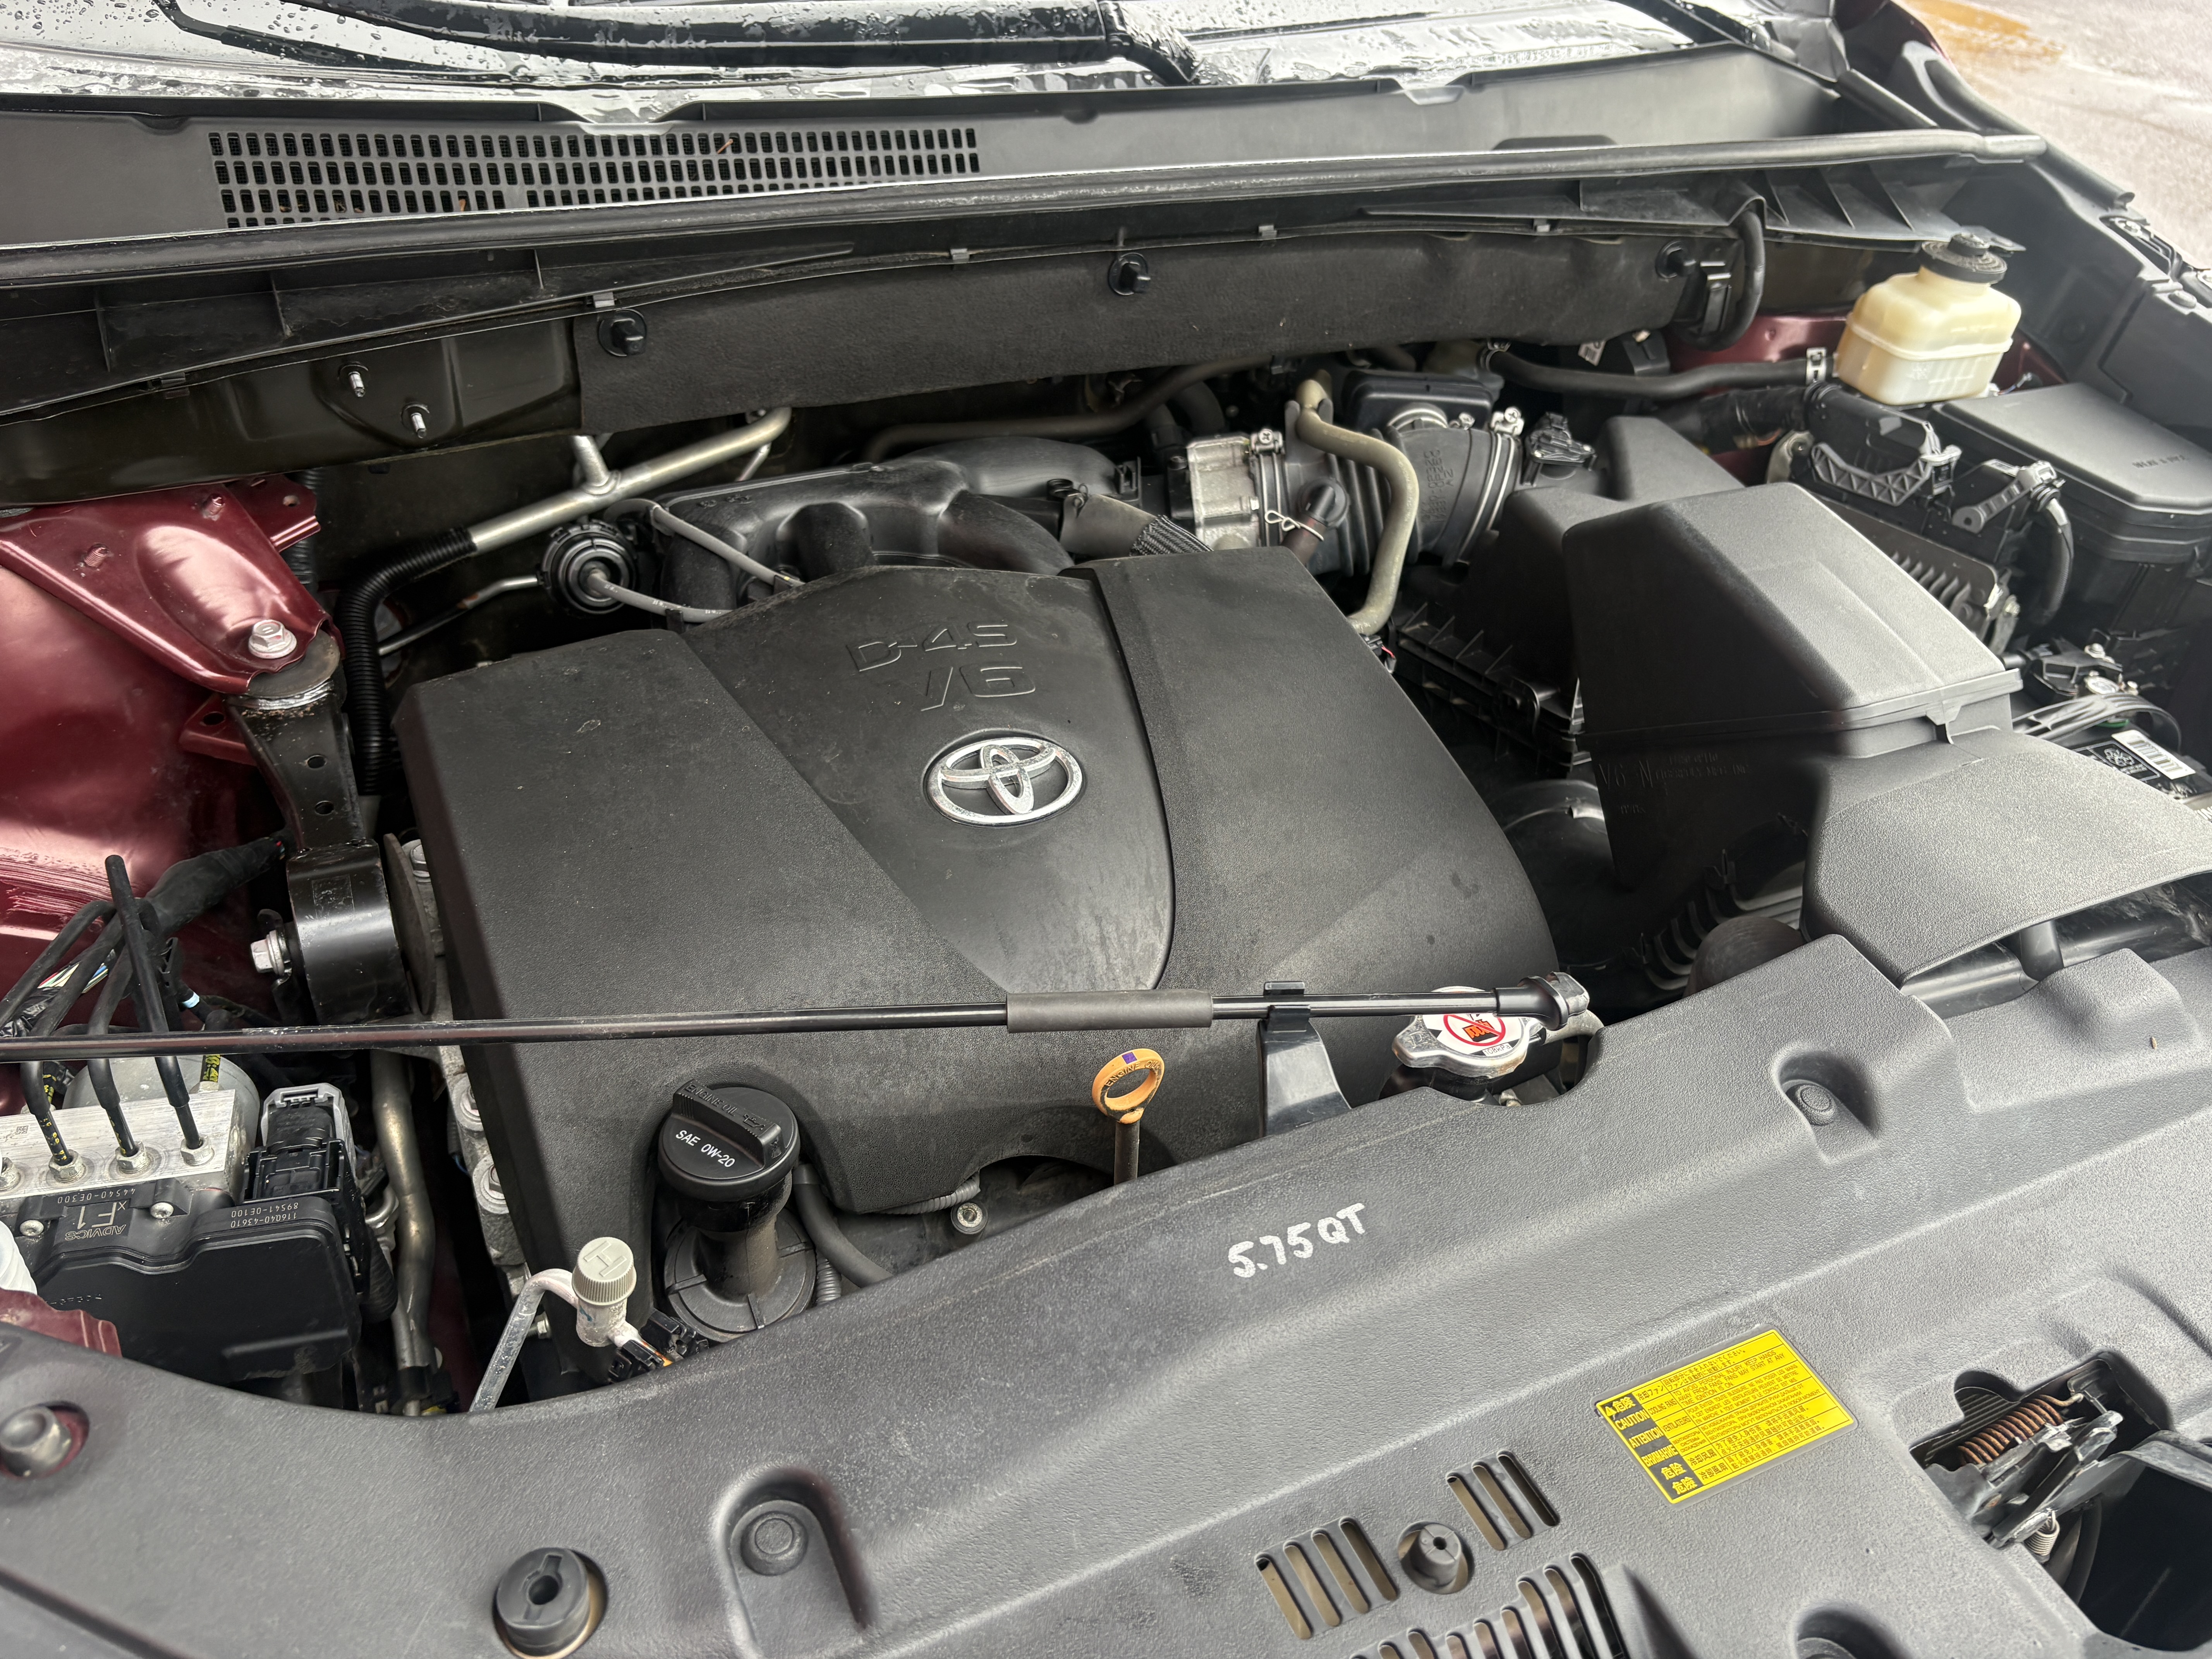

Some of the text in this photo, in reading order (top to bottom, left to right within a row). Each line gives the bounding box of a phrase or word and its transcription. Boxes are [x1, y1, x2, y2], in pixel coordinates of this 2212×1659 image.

[845, 620, 1018, 672] D-4S
[1484, 1043, 1511, 1056] 108kPa
[1105, 1062, 1141, 1087] ENGINE
[684, 1084, 738, 1116] ENGINE OIL
[675, 1130, 736, 1168] SAE 0W-20
[231, 1201, 299, 1219] 89541-0E100
[65, 1224, 127, 1241] ADVICS
[1678, 1393, 1692, 1401] AWAY
[1692, 1385, 1708, 1395] FROM
[1723, 1373, 1738, 1381] FANS
[1750, 1360, 1765, 1370] START
[1682, 1383, 1698, 1393] AVOID
[1698, 1372, 1725, 1386] PERSONAL
[1744, 1357, 1757, 1366] KEEP
[1759, 1350, 1776, 1360] HANDS
[1636, 1385, 1663, 1400] 冷却ファン
[1695, 1388, 1717, 1400] IGNITION
[1732, 1387, 1759, 1401] VENTILATEURS
[1758, 1379, 1775, 1389] PEUVENT
[1782, 1370, 1798, 1379] METTRE
[1647, 1398, 1677, 1415] COOLING FANS
[1702, 1411, 1719, 1420] MARCHE
[1734, 1397, 1751, 1407] MOMENT
[1762, 1384, 1780, 1395] CONTACT
[1615, 1409, 1650, 1430] CAUTION
[1662, 1415, 1691, 1432] VENTILATEURS
[1629, 1427, 1664, 1448] ATTENTION
[1642, 1444, 1678, 1467] ВНИМАНИЕ
[1688, 1448, 1717, 1465] 冷却风扇
